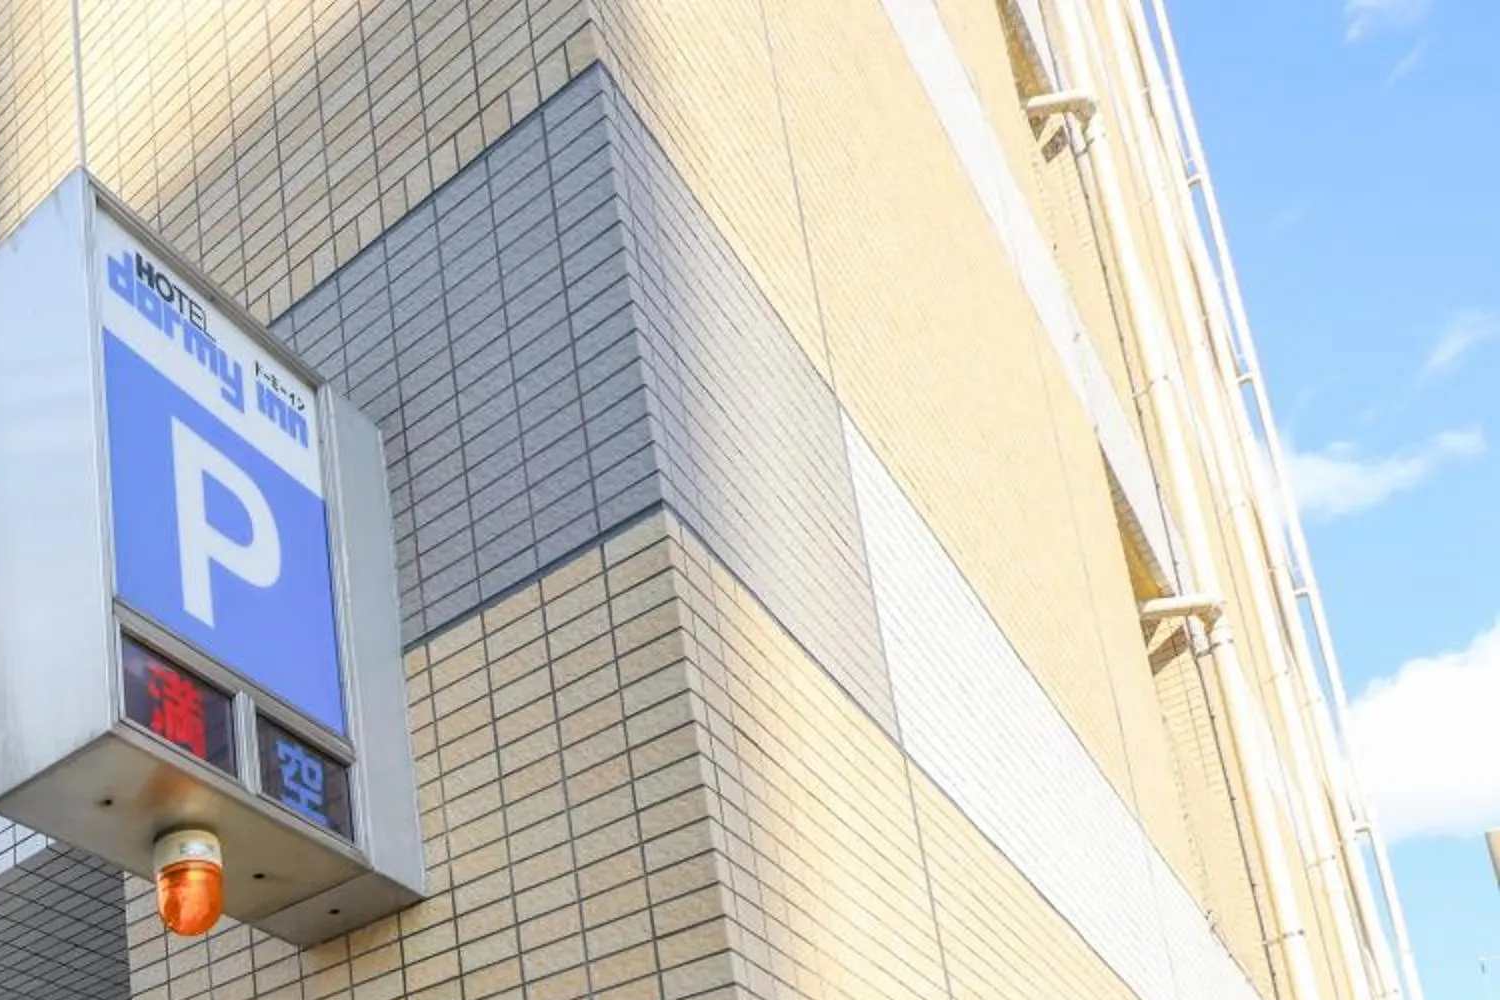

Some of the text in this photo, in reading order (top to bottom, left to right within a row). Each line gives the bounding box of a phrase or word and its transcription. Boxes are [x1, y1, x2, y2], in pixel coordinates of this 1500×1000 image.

[136, 252, 216, 343] HOTEL
[107, 251, 308, 449] dormy inn
[171, 415, 281, 630] P
[146, 659, 207, 761] 満
[276, 738, 330, 829] 空
